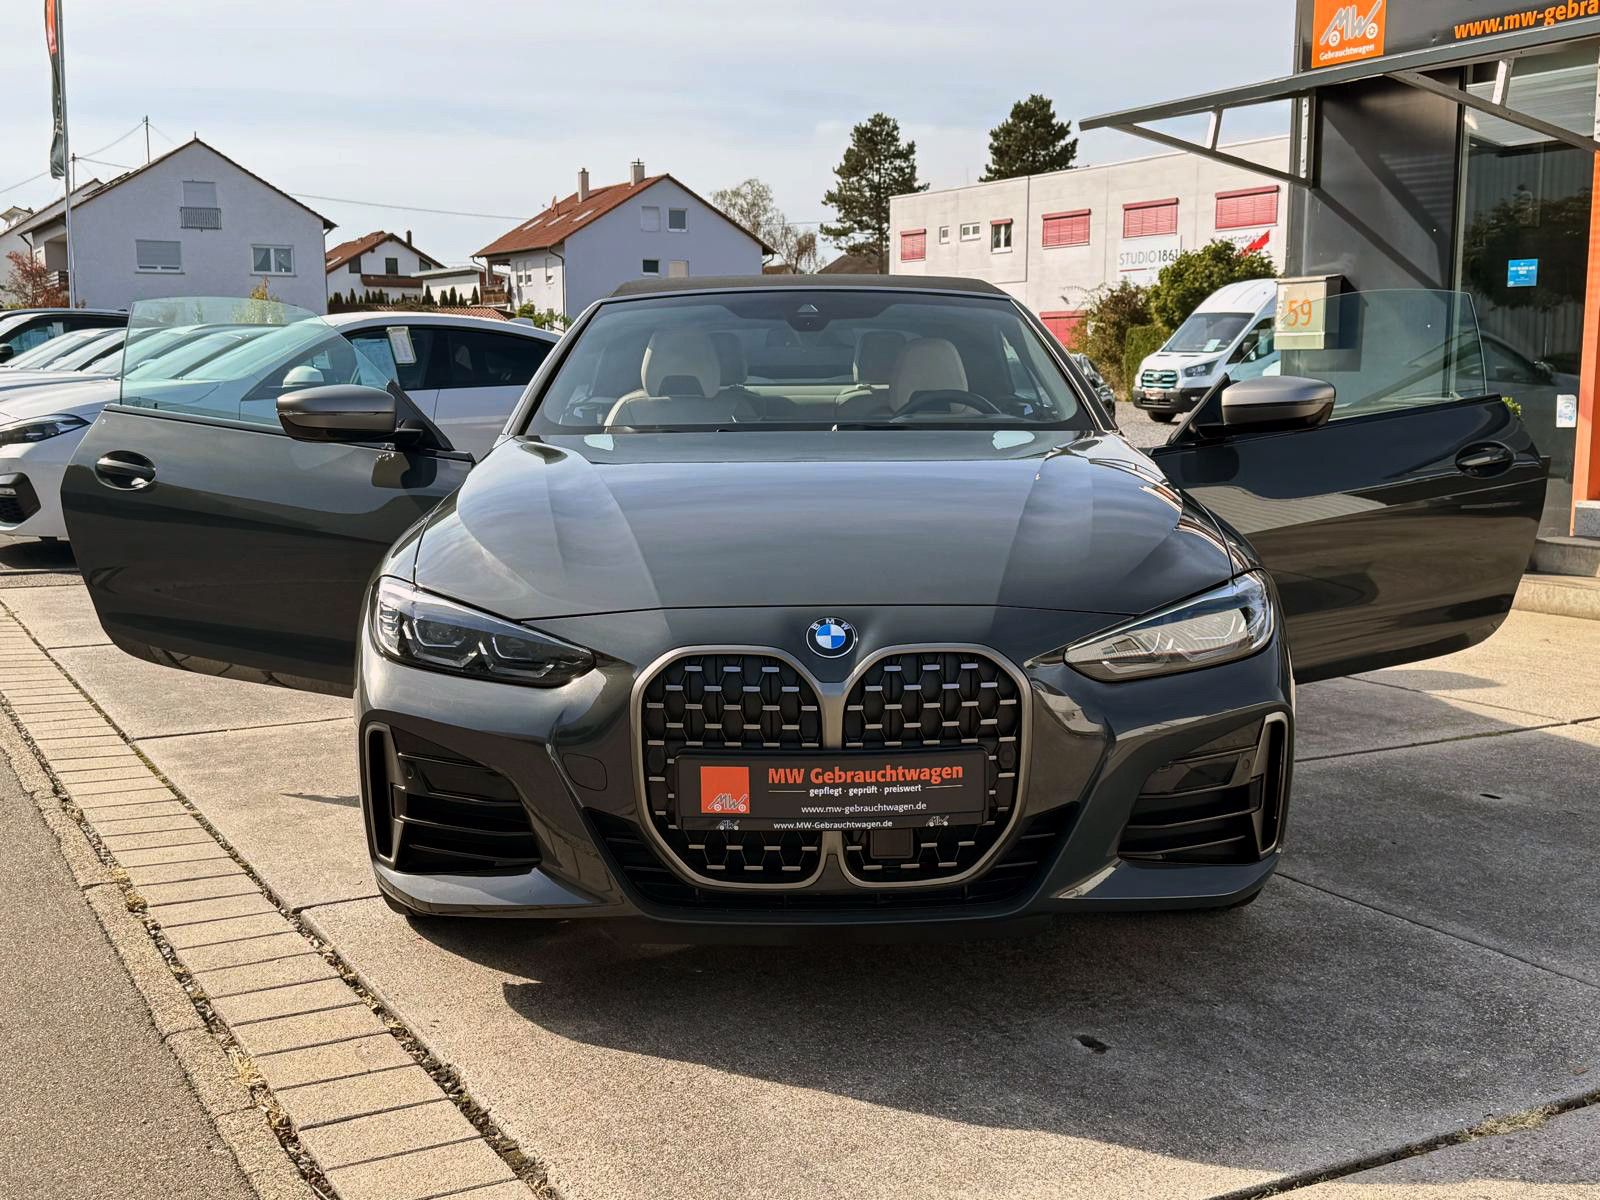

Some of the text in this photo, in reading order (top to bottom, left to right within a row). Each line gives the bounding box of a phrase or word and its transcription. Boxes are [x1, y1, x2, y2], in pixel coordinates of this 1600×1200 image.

[1319, 44, 1375, 61] Gebrauchtwagen
[1286, 299, 1312, 327] 59
[810, 618, 851, 631] BMW
[768, 765, 963, 785] MW Gebrauchtwagen
[809, 784, 922, 797] gepflegt geprüft preiswert
[801, 801, 927, 814] www.mw-gebrauchtwagen.de
[773, 819, 893, 831] www.MW-Gebrauchtwagen.de
